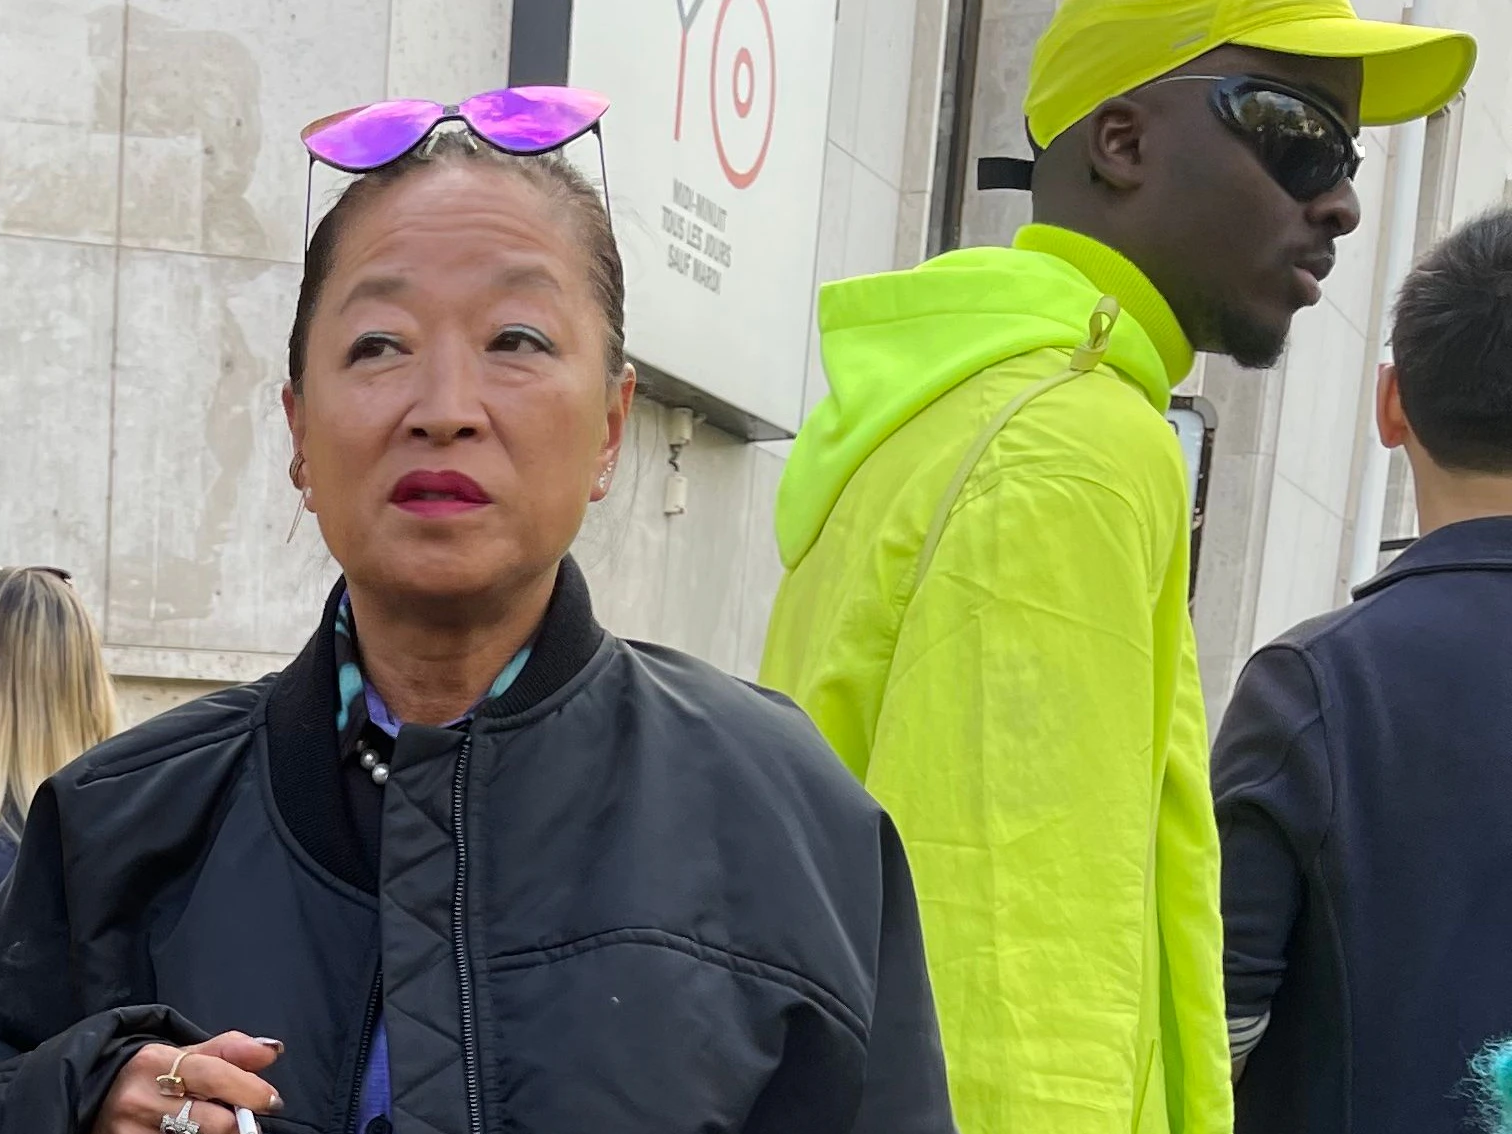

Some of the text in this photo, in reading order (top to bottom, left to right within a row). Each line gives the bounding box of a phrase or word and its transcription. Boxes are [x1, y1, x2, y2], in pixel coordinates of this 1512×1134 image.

[662, 205, 732, 268] TOUS LES JOURS
[667, 244, 721, 295] SAUF MARDI
